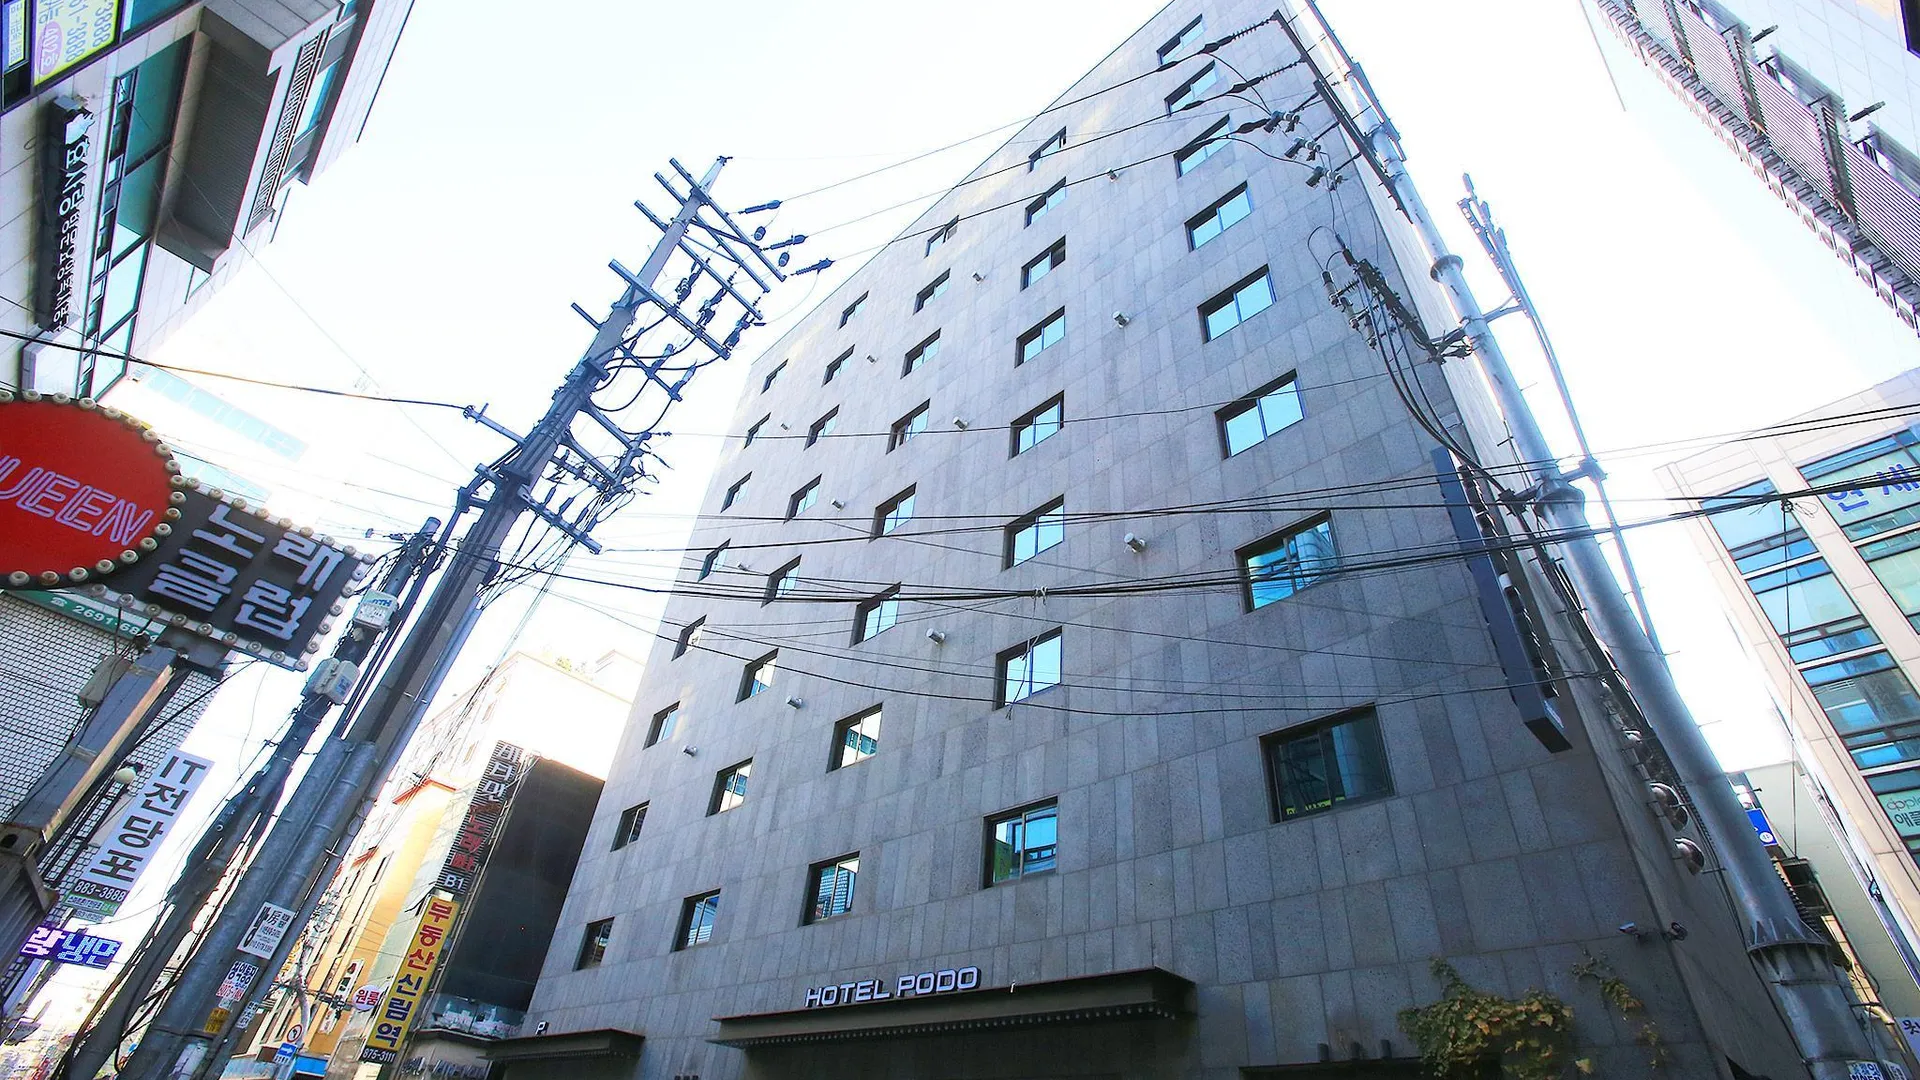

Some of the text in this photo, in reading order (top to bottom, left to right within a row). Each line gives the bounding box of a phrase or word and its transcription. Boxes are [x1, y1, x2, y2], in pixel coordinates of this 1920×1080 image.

[59, 137, 90, 216] 효사랑
[192, 504, 345, 592] 노래
[148, 548, 313, 641] 클럽
[90, 755, 207, 882] IT전당포
[74, 881, 127, 902] 883-3888
[444, 873, 464, 890] B1
[407, 901, 453, 972] 부동산
[356, 989, 380, 1006] 원룸
[375, 973, 423, 1047] 신림역
[805, 966, 979, 1007] HOTEL PODO
[362, 1048, 396, 1063] 875-3111
[535, 1020, 548, 1035] P
